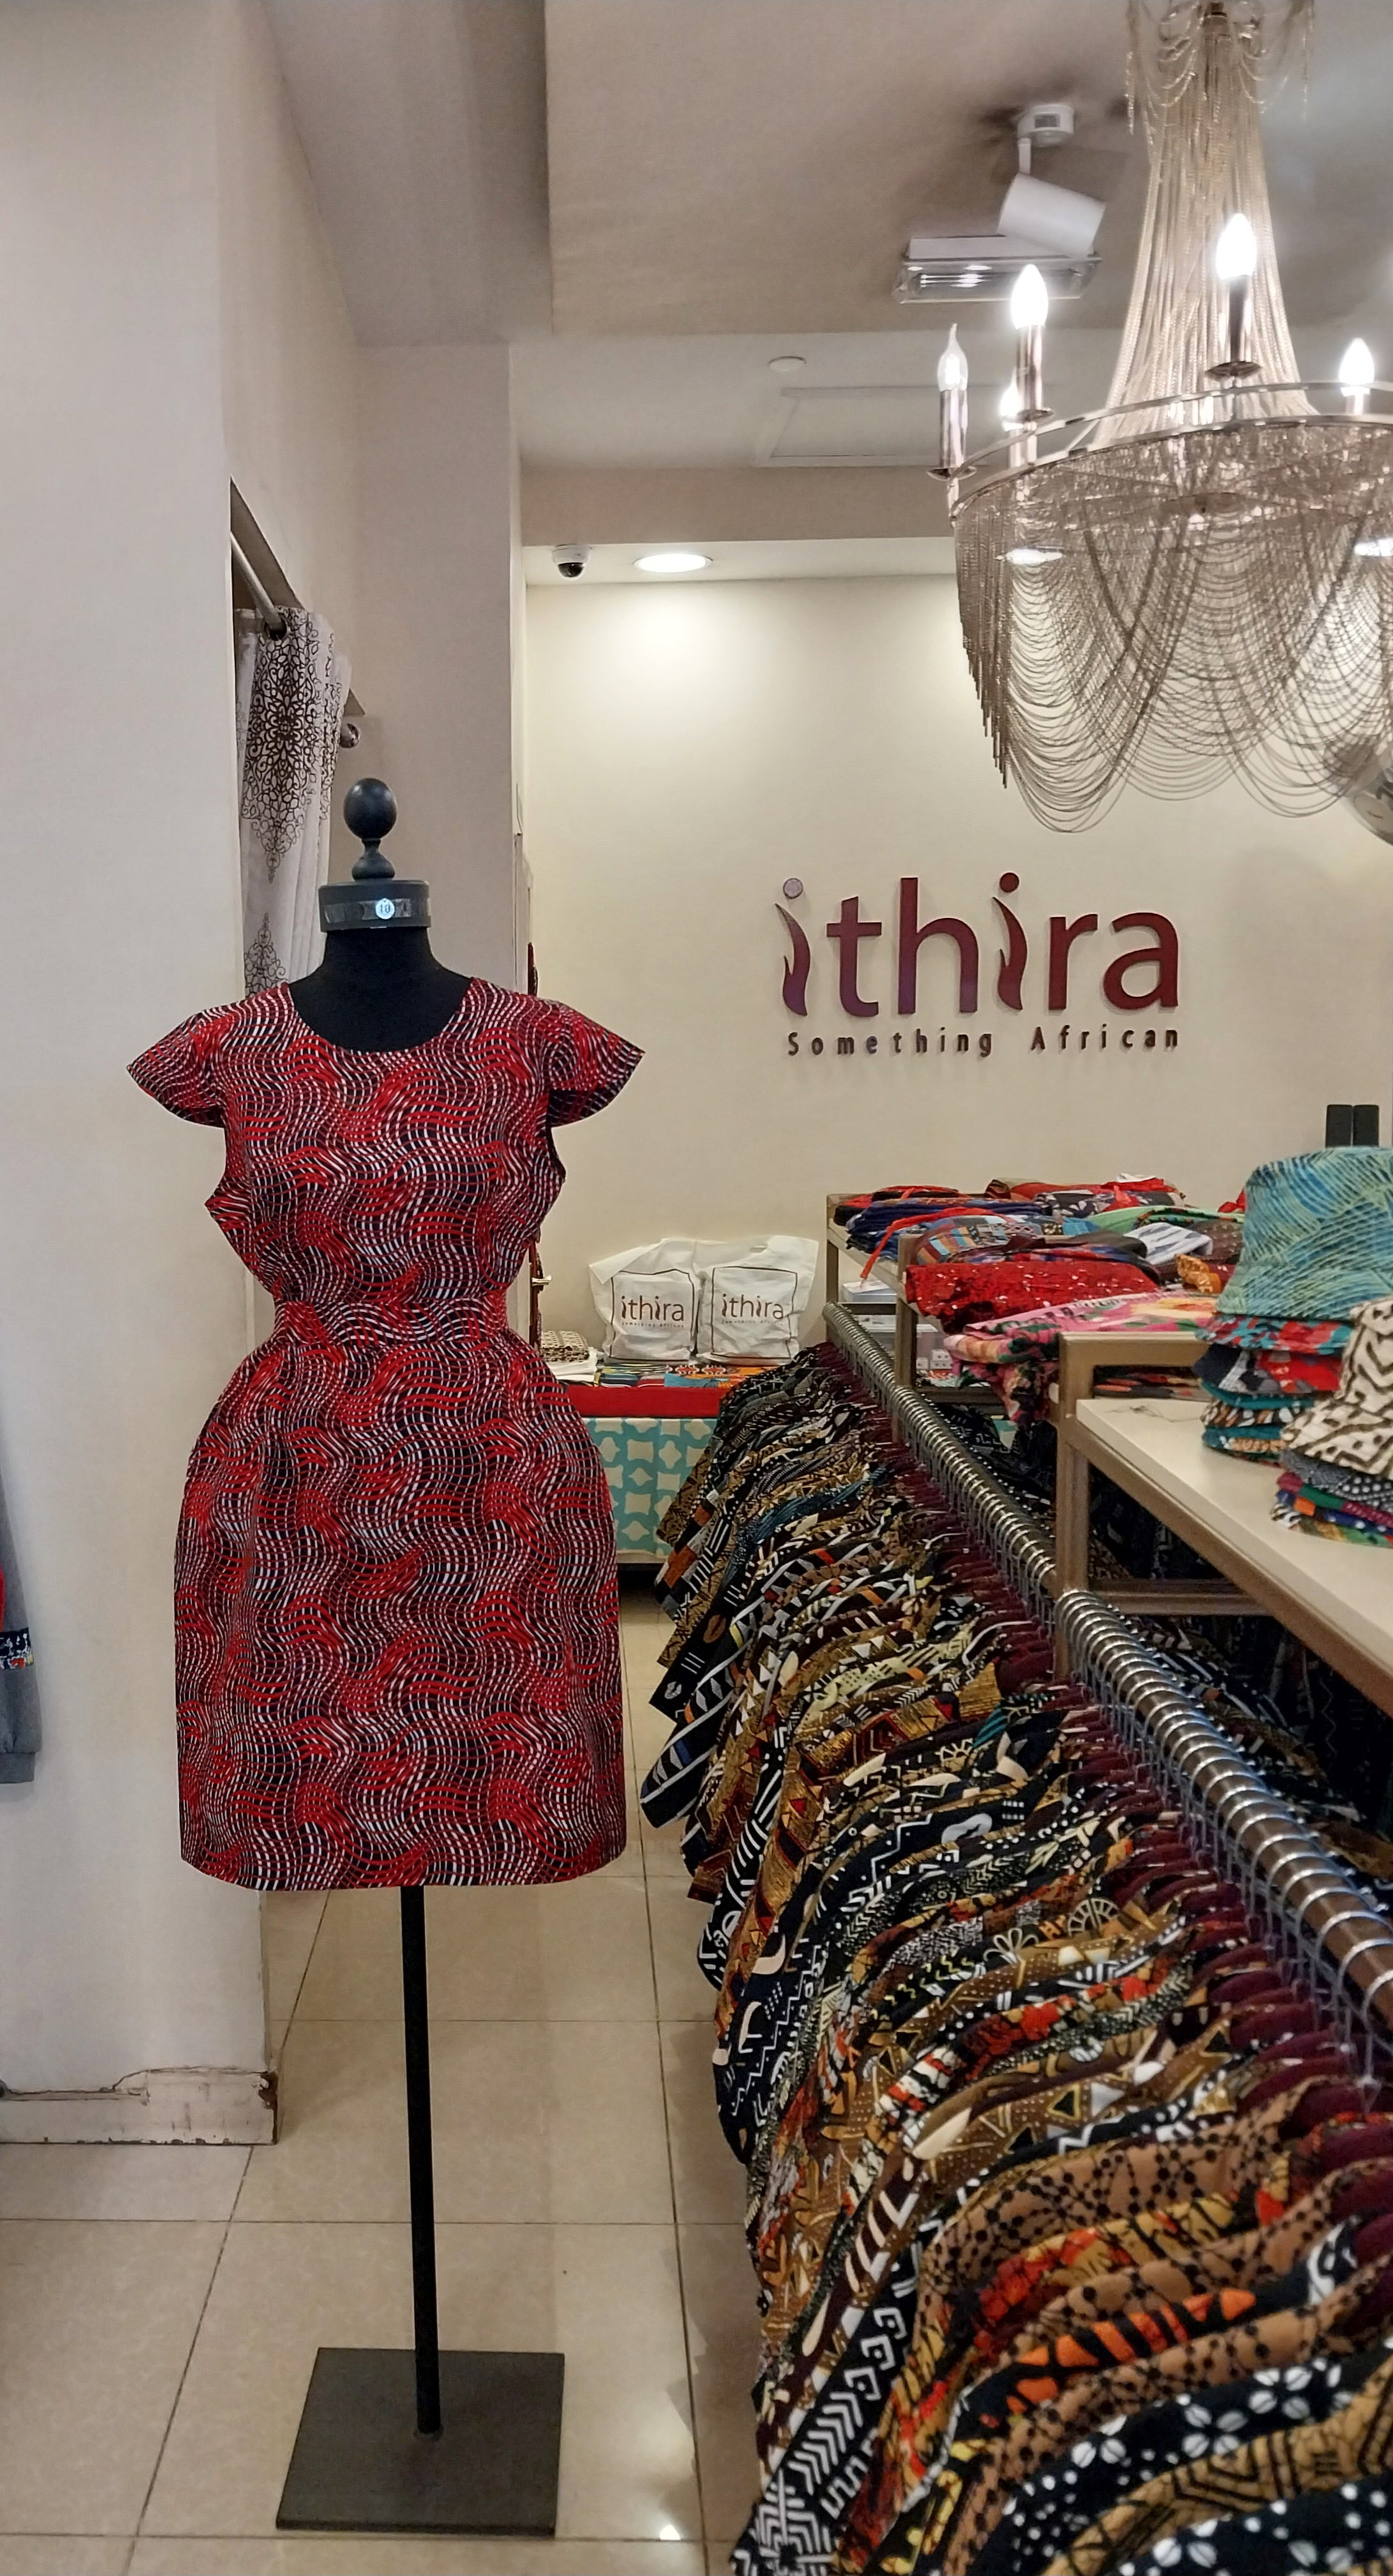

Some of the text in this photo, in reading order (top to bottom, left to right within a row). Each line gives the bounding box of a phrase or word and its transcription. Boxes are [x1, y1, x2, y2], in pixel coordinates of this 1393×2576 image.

[774, 872, 1178, 1018] ithira
[788, 1024, 1178, 1058] Something African
[621, 1295, 684, 1322] ithira
[721, 1293, 784, 1320] ithira
